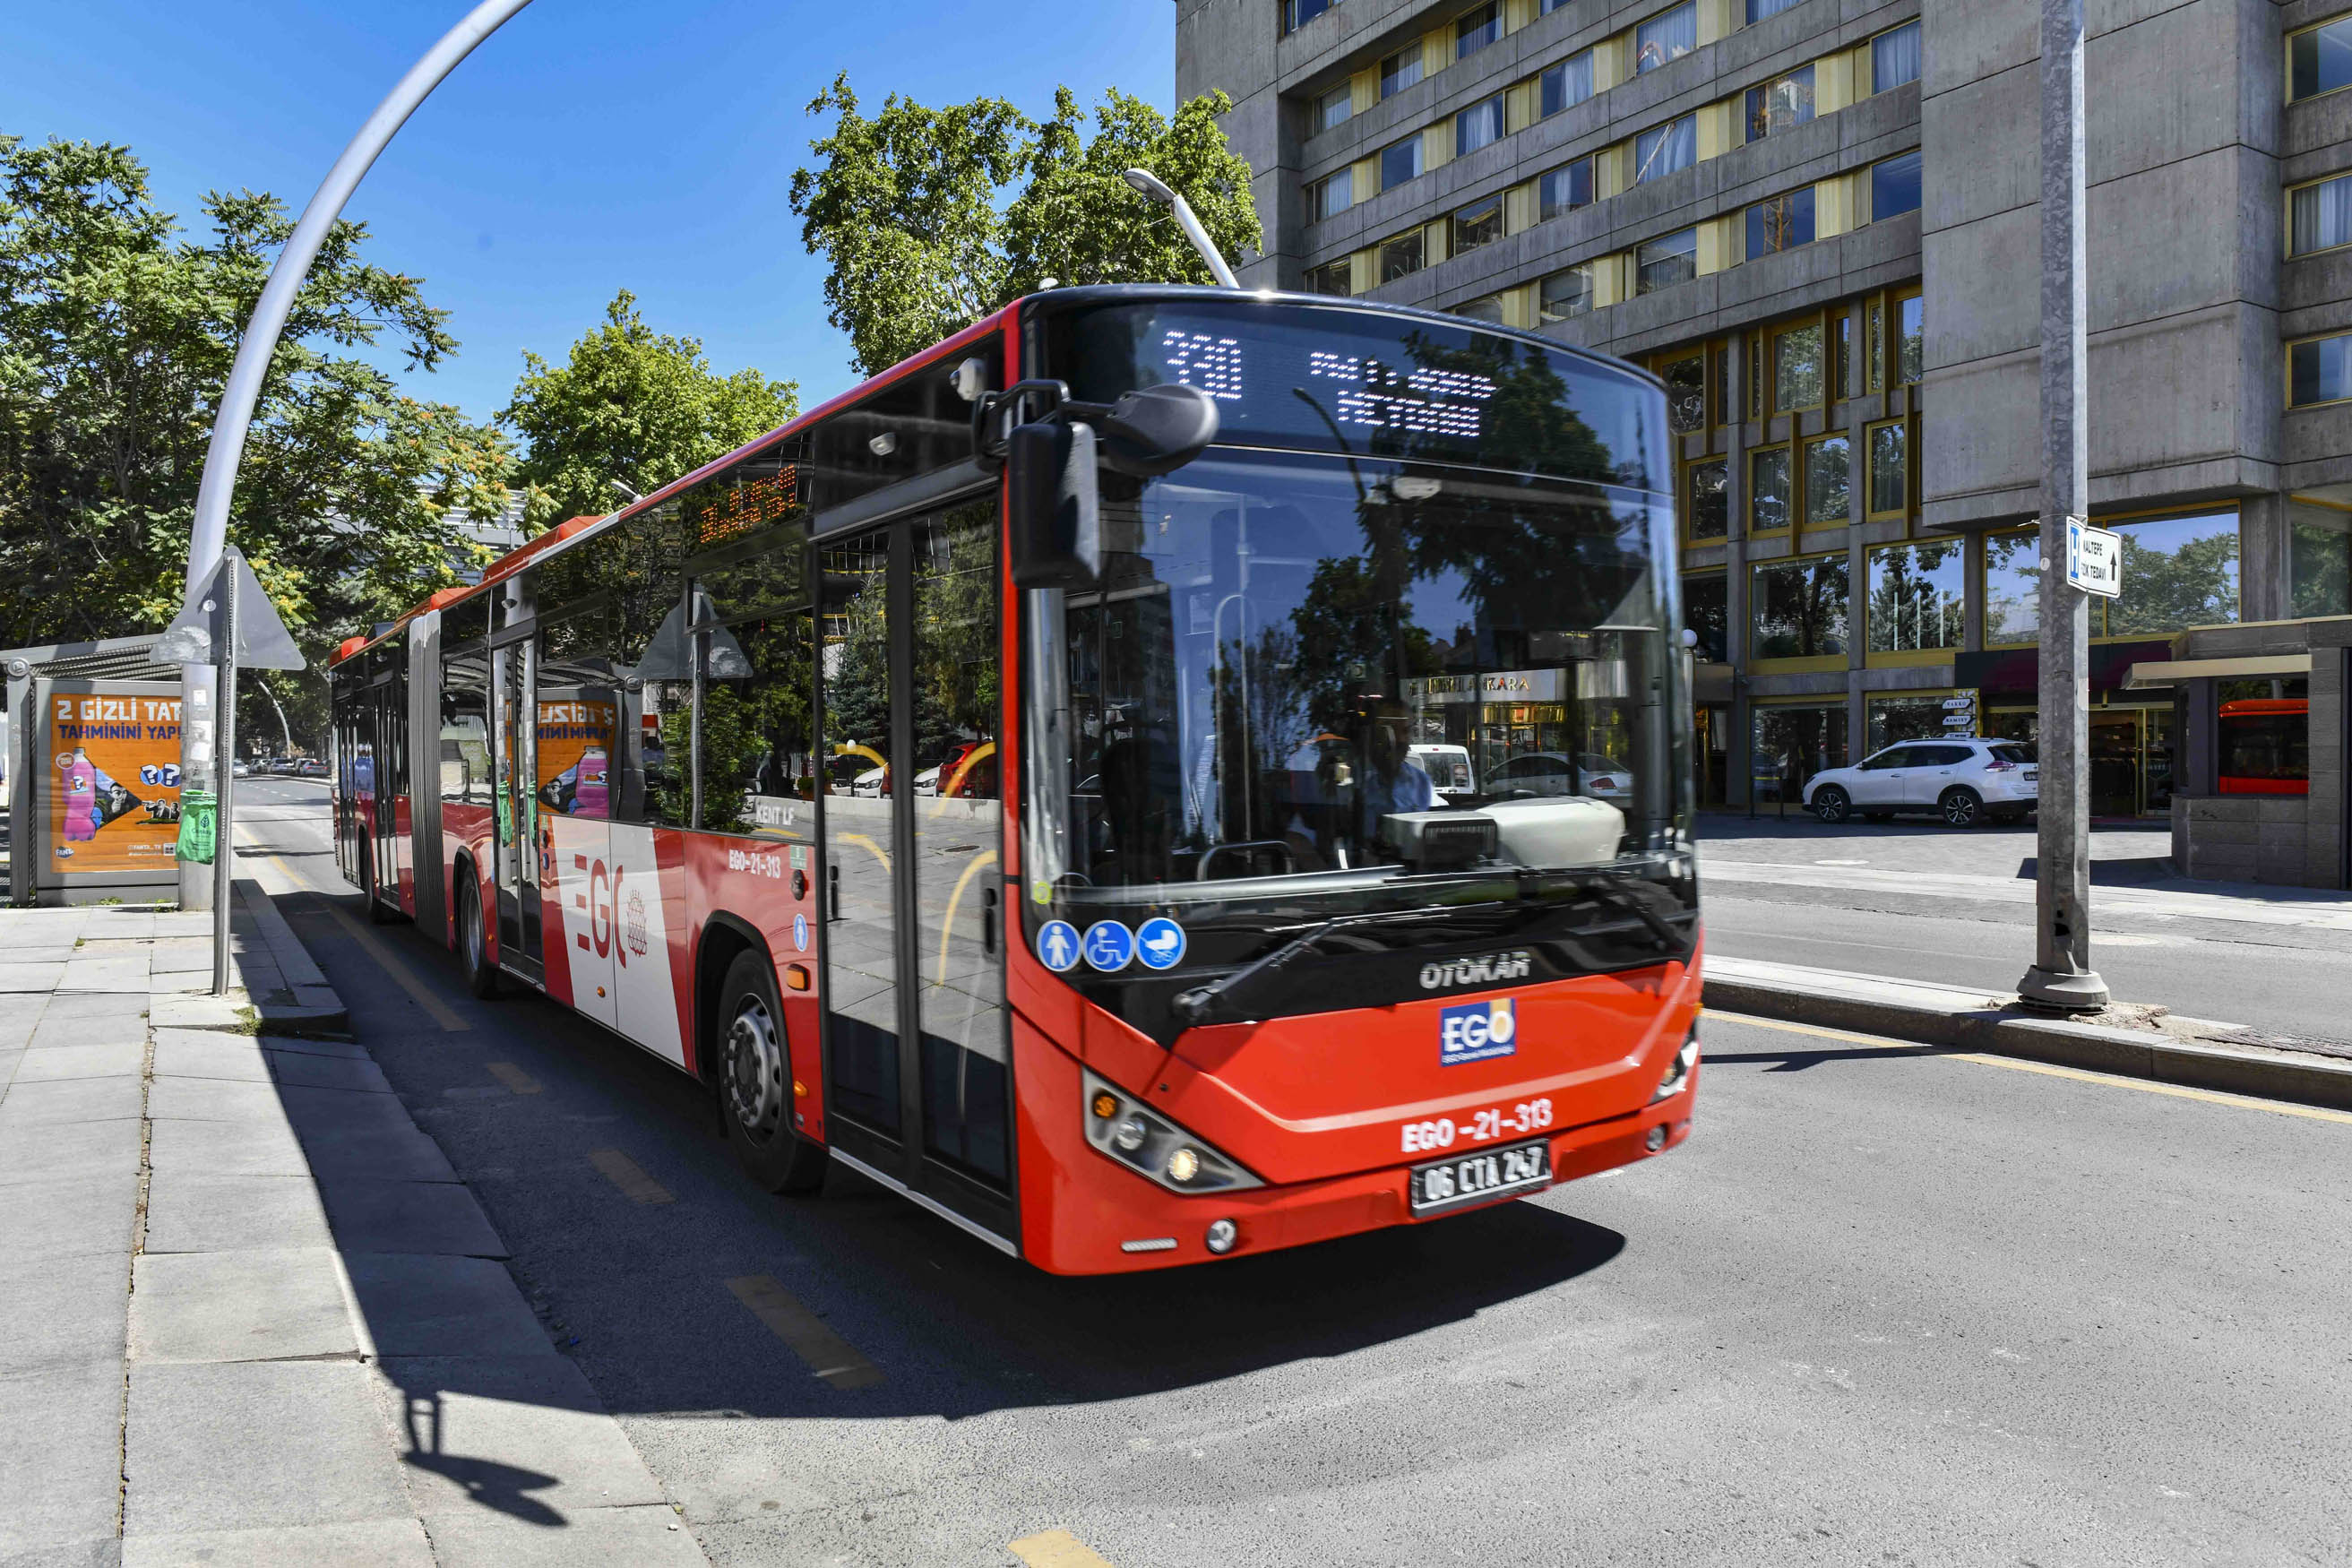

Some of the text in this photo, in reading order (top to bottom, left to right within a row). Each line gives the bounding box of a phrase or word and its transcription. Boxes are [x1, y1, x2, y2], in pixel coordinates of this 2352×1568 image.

[57, 700, 73, 720] 2
[80, 695, 137, 720] GİZLİ
[57, 722, 142, 739] TAHMİNİNİ
[755, 806, 780, 824] KENT
[1419, 951, 1530, 989] OTOKAR
[1441, 1010, 1515, 1052] EGO
[1425, 1166, 1455, 1201] 06
